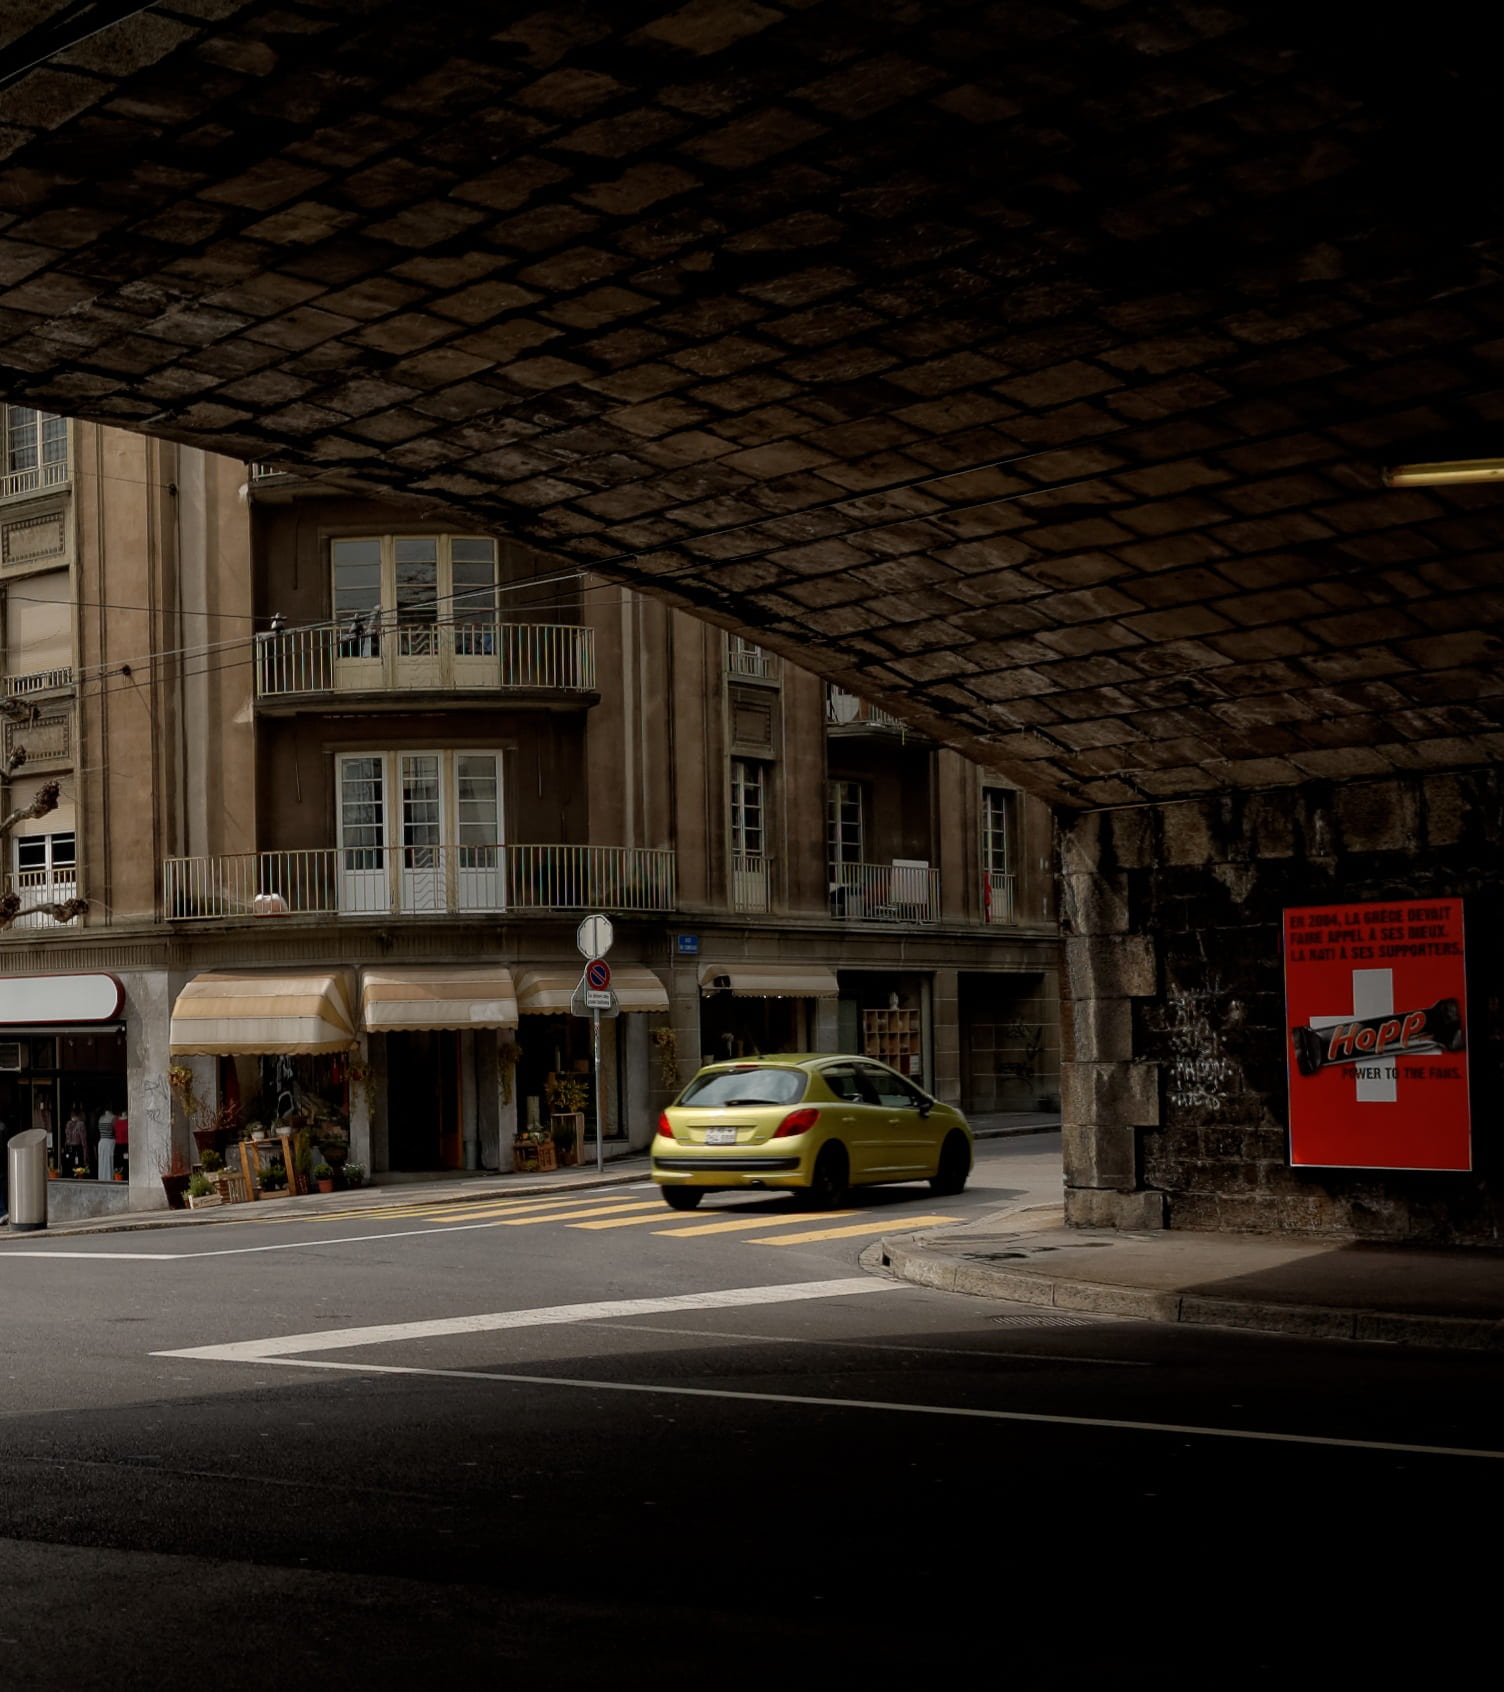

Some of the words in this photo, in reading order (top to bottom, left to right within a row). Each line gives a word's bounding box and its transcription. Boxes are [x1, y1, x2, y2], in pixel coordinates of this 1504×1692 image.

[1345, 912, 1361, 926] LA
[1328, 928, 1363, 943] APPEL
[1380, 926, 1405, 940] SES
[1290, 949, 1306, 962] LA
[1351, 945, 1375, 960] SES
[1328, 1011, 1426, 1060] Hopp
[1342, 1067, 1381, 1080] POWER
[1385, 1067, 1400, 1080] TO
[1404, 1066, 1426, 1079] THE
